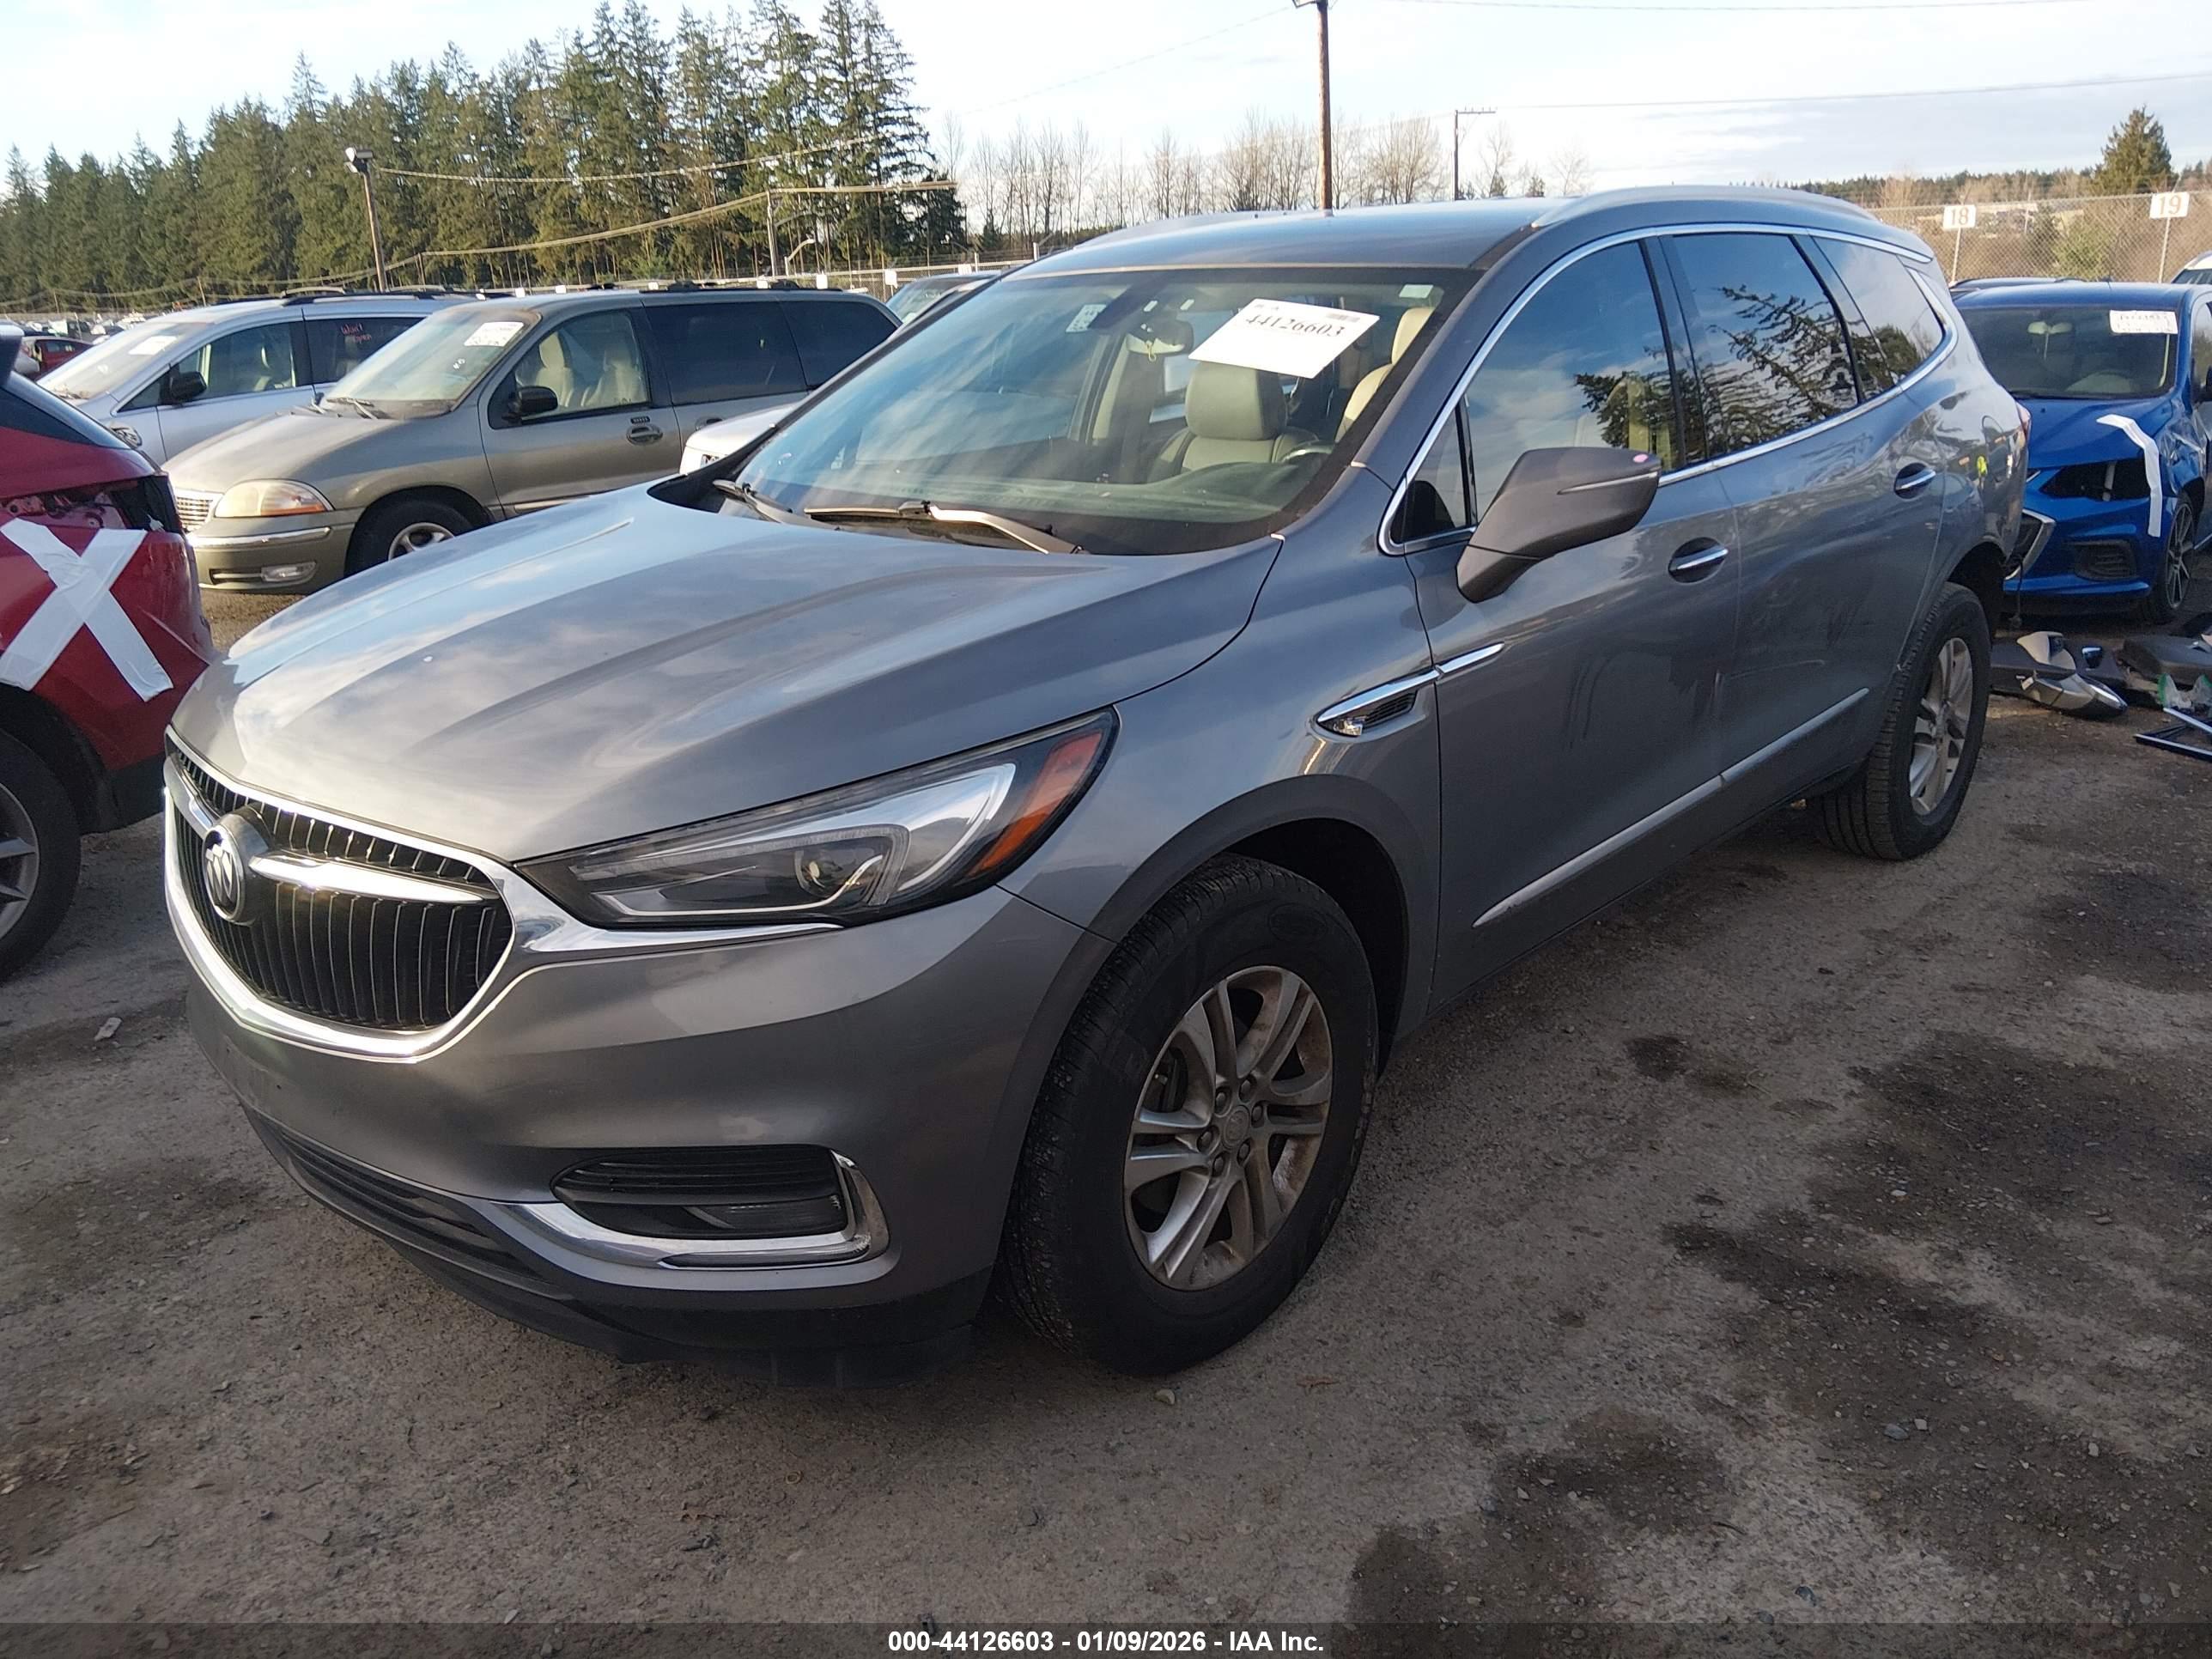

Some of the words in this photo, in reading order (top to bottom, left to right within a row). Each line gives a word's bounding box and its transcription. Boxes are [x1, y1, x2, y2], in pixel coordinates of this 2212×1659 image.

[2159, 195, 2181, 215] 19
[1951, 207, 1969, 225] 18
[1245, 314, 1346, 337] 44126603
